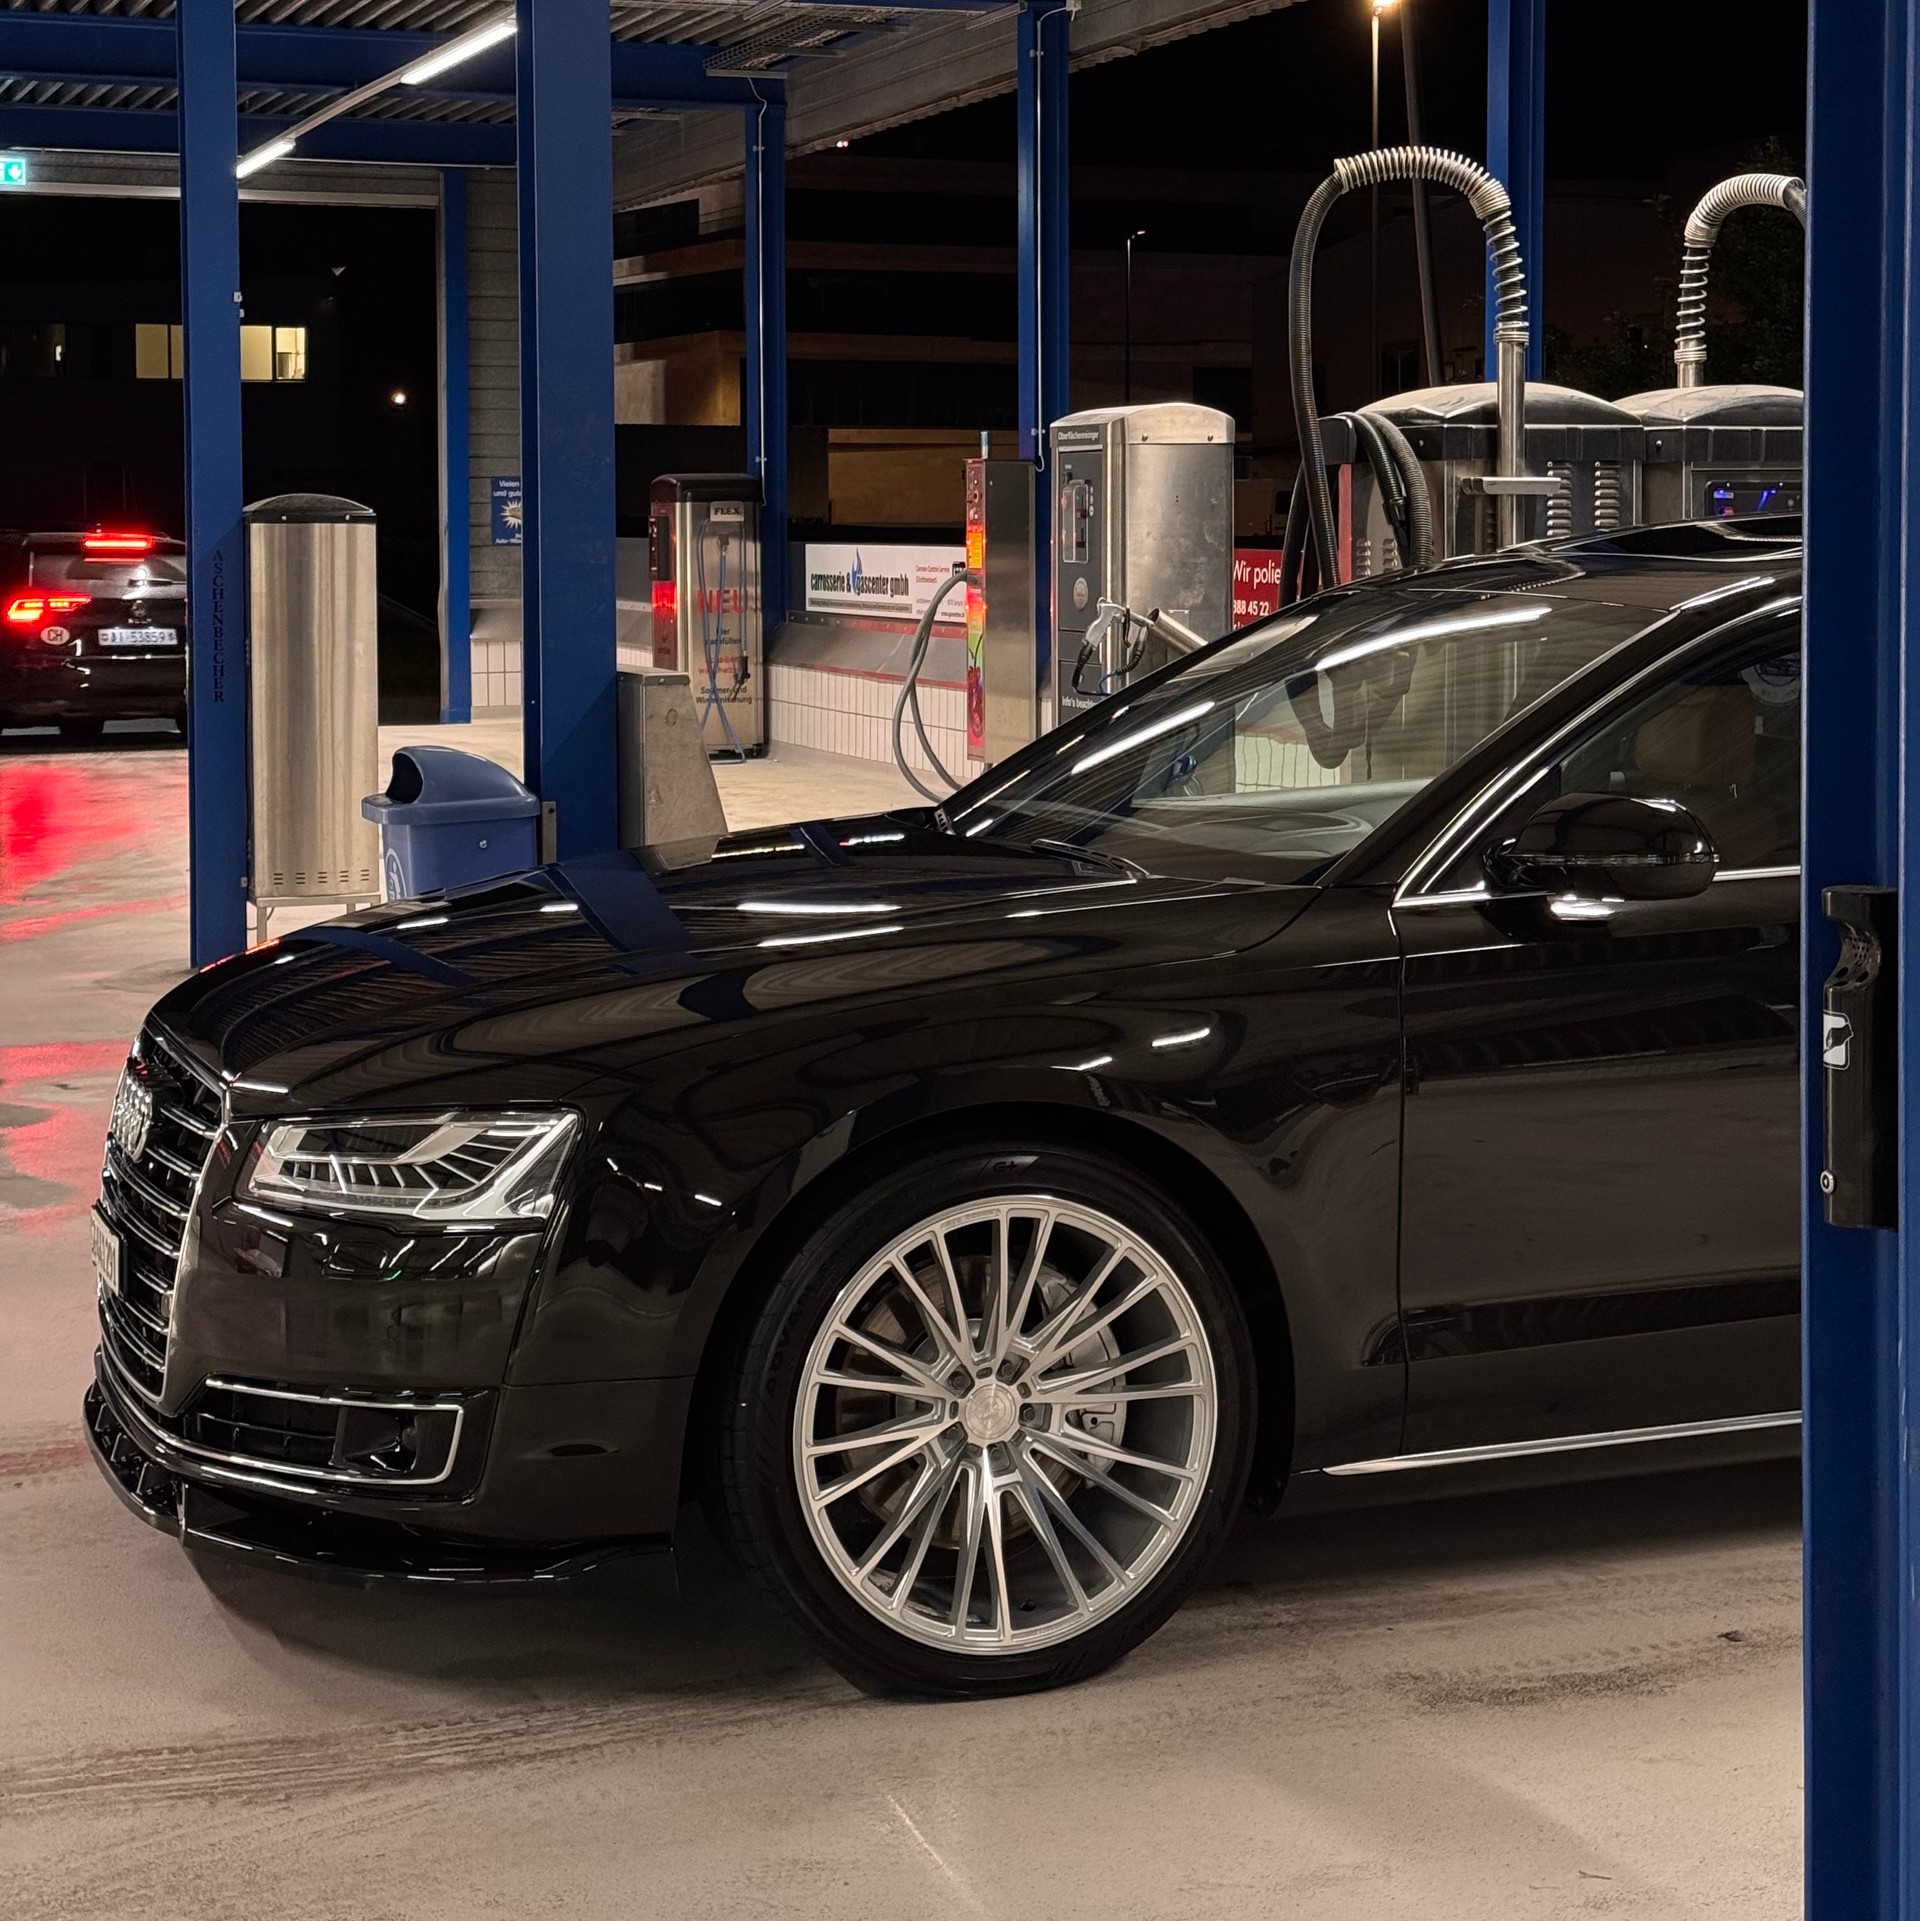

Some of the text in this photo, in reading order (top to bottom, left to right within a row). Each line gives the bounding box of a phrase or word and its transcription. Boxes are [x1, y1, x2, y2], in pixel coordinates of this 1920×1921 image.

[498, 480, 520, 488] Vielen
[713, 507, 740, 516] FLEX
[1233, 559, 1251, 583] Wir
[810, 571, 909, 598] carrosserie & gascenter gmbh
[1247, 601, 1258, 616] 45
[1259, 602, 1269, 616] 22
[212, 549, 225, 702] ASCHENBECHER
